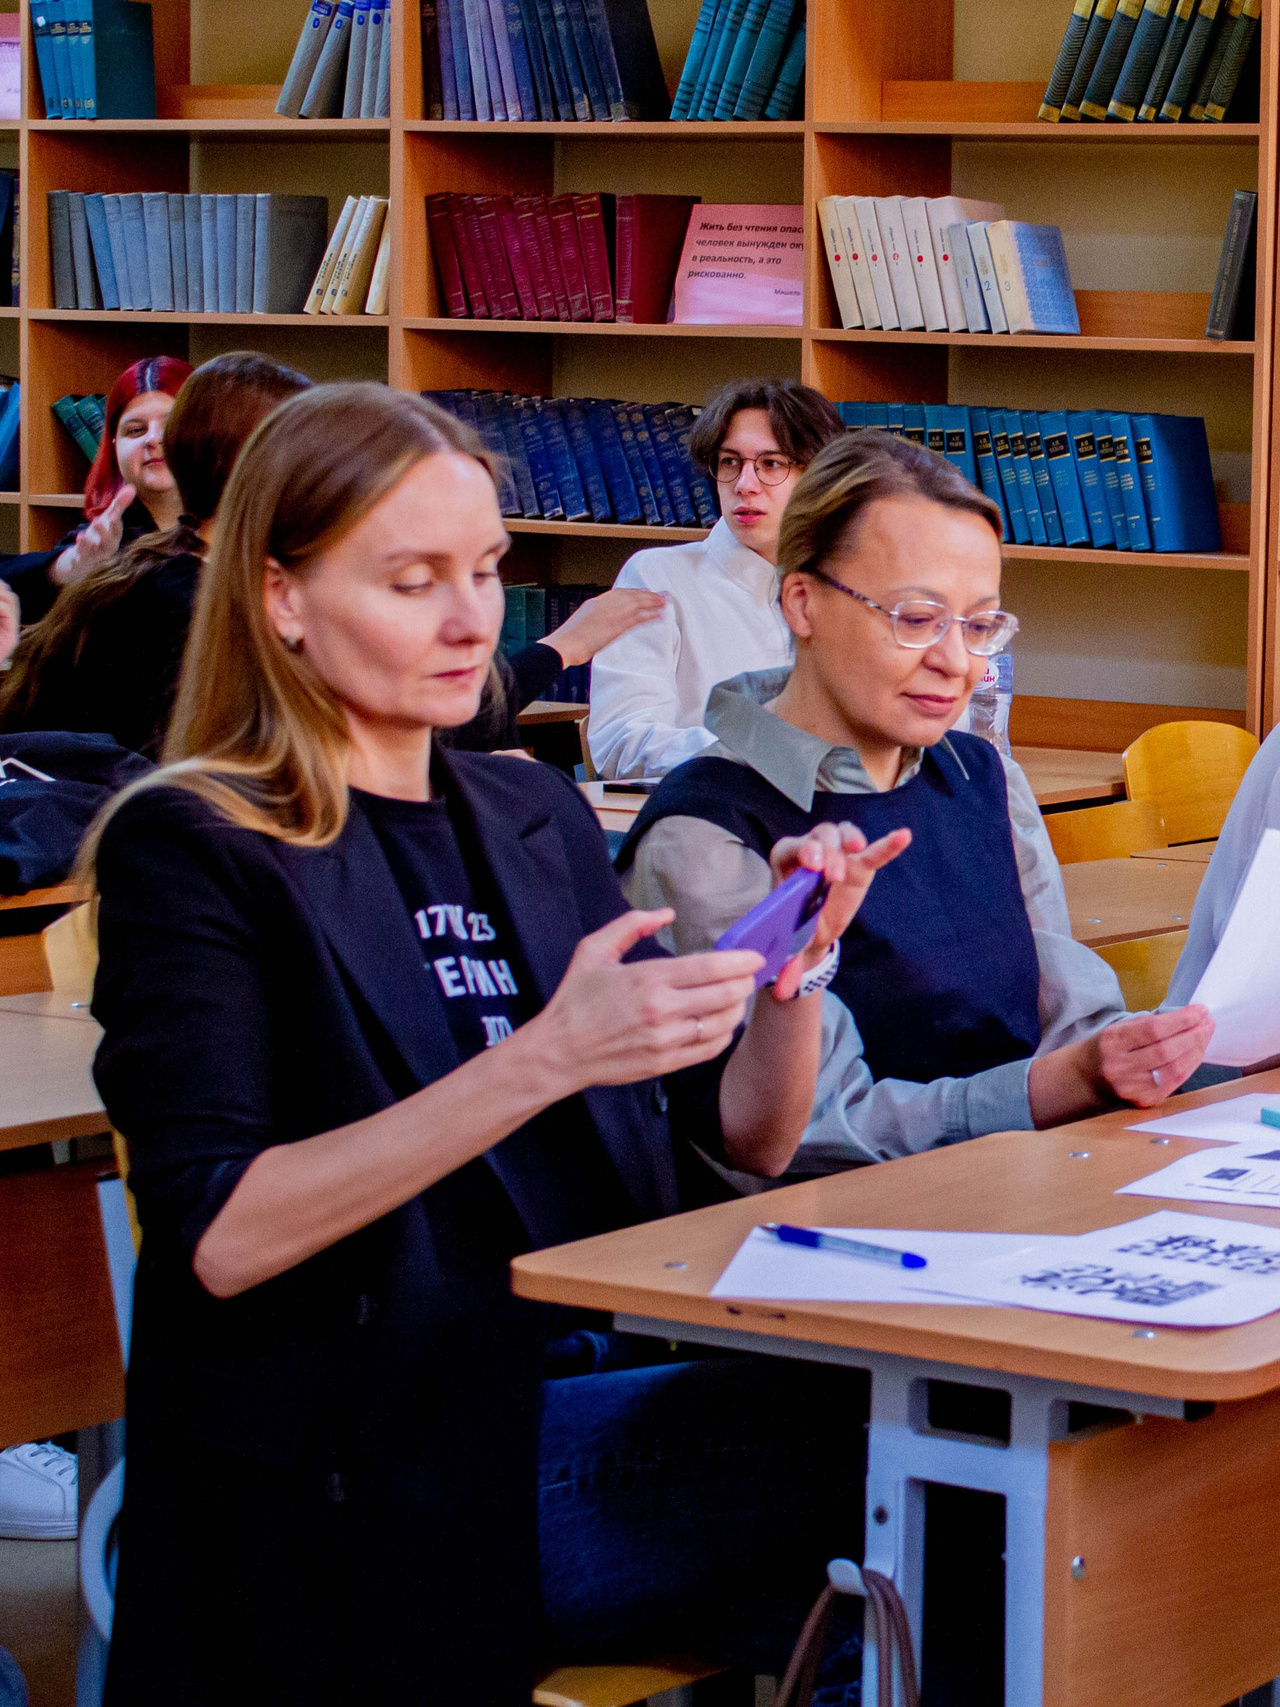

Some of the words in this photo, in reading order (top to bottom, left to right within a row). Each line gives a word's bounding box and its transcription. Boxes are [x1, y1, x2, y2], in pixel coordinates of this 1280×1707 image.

[700, 222, 725, 231] Жить
[727, 222, 742, 231] без
[745, 225, 778, 233] чтения
[696, 239, 734, 247] человек
[736, 241, 787, 250] вынужден
[699, 255, 755, 264] реальность,
[687, 270, 746, 279] рискованно.
